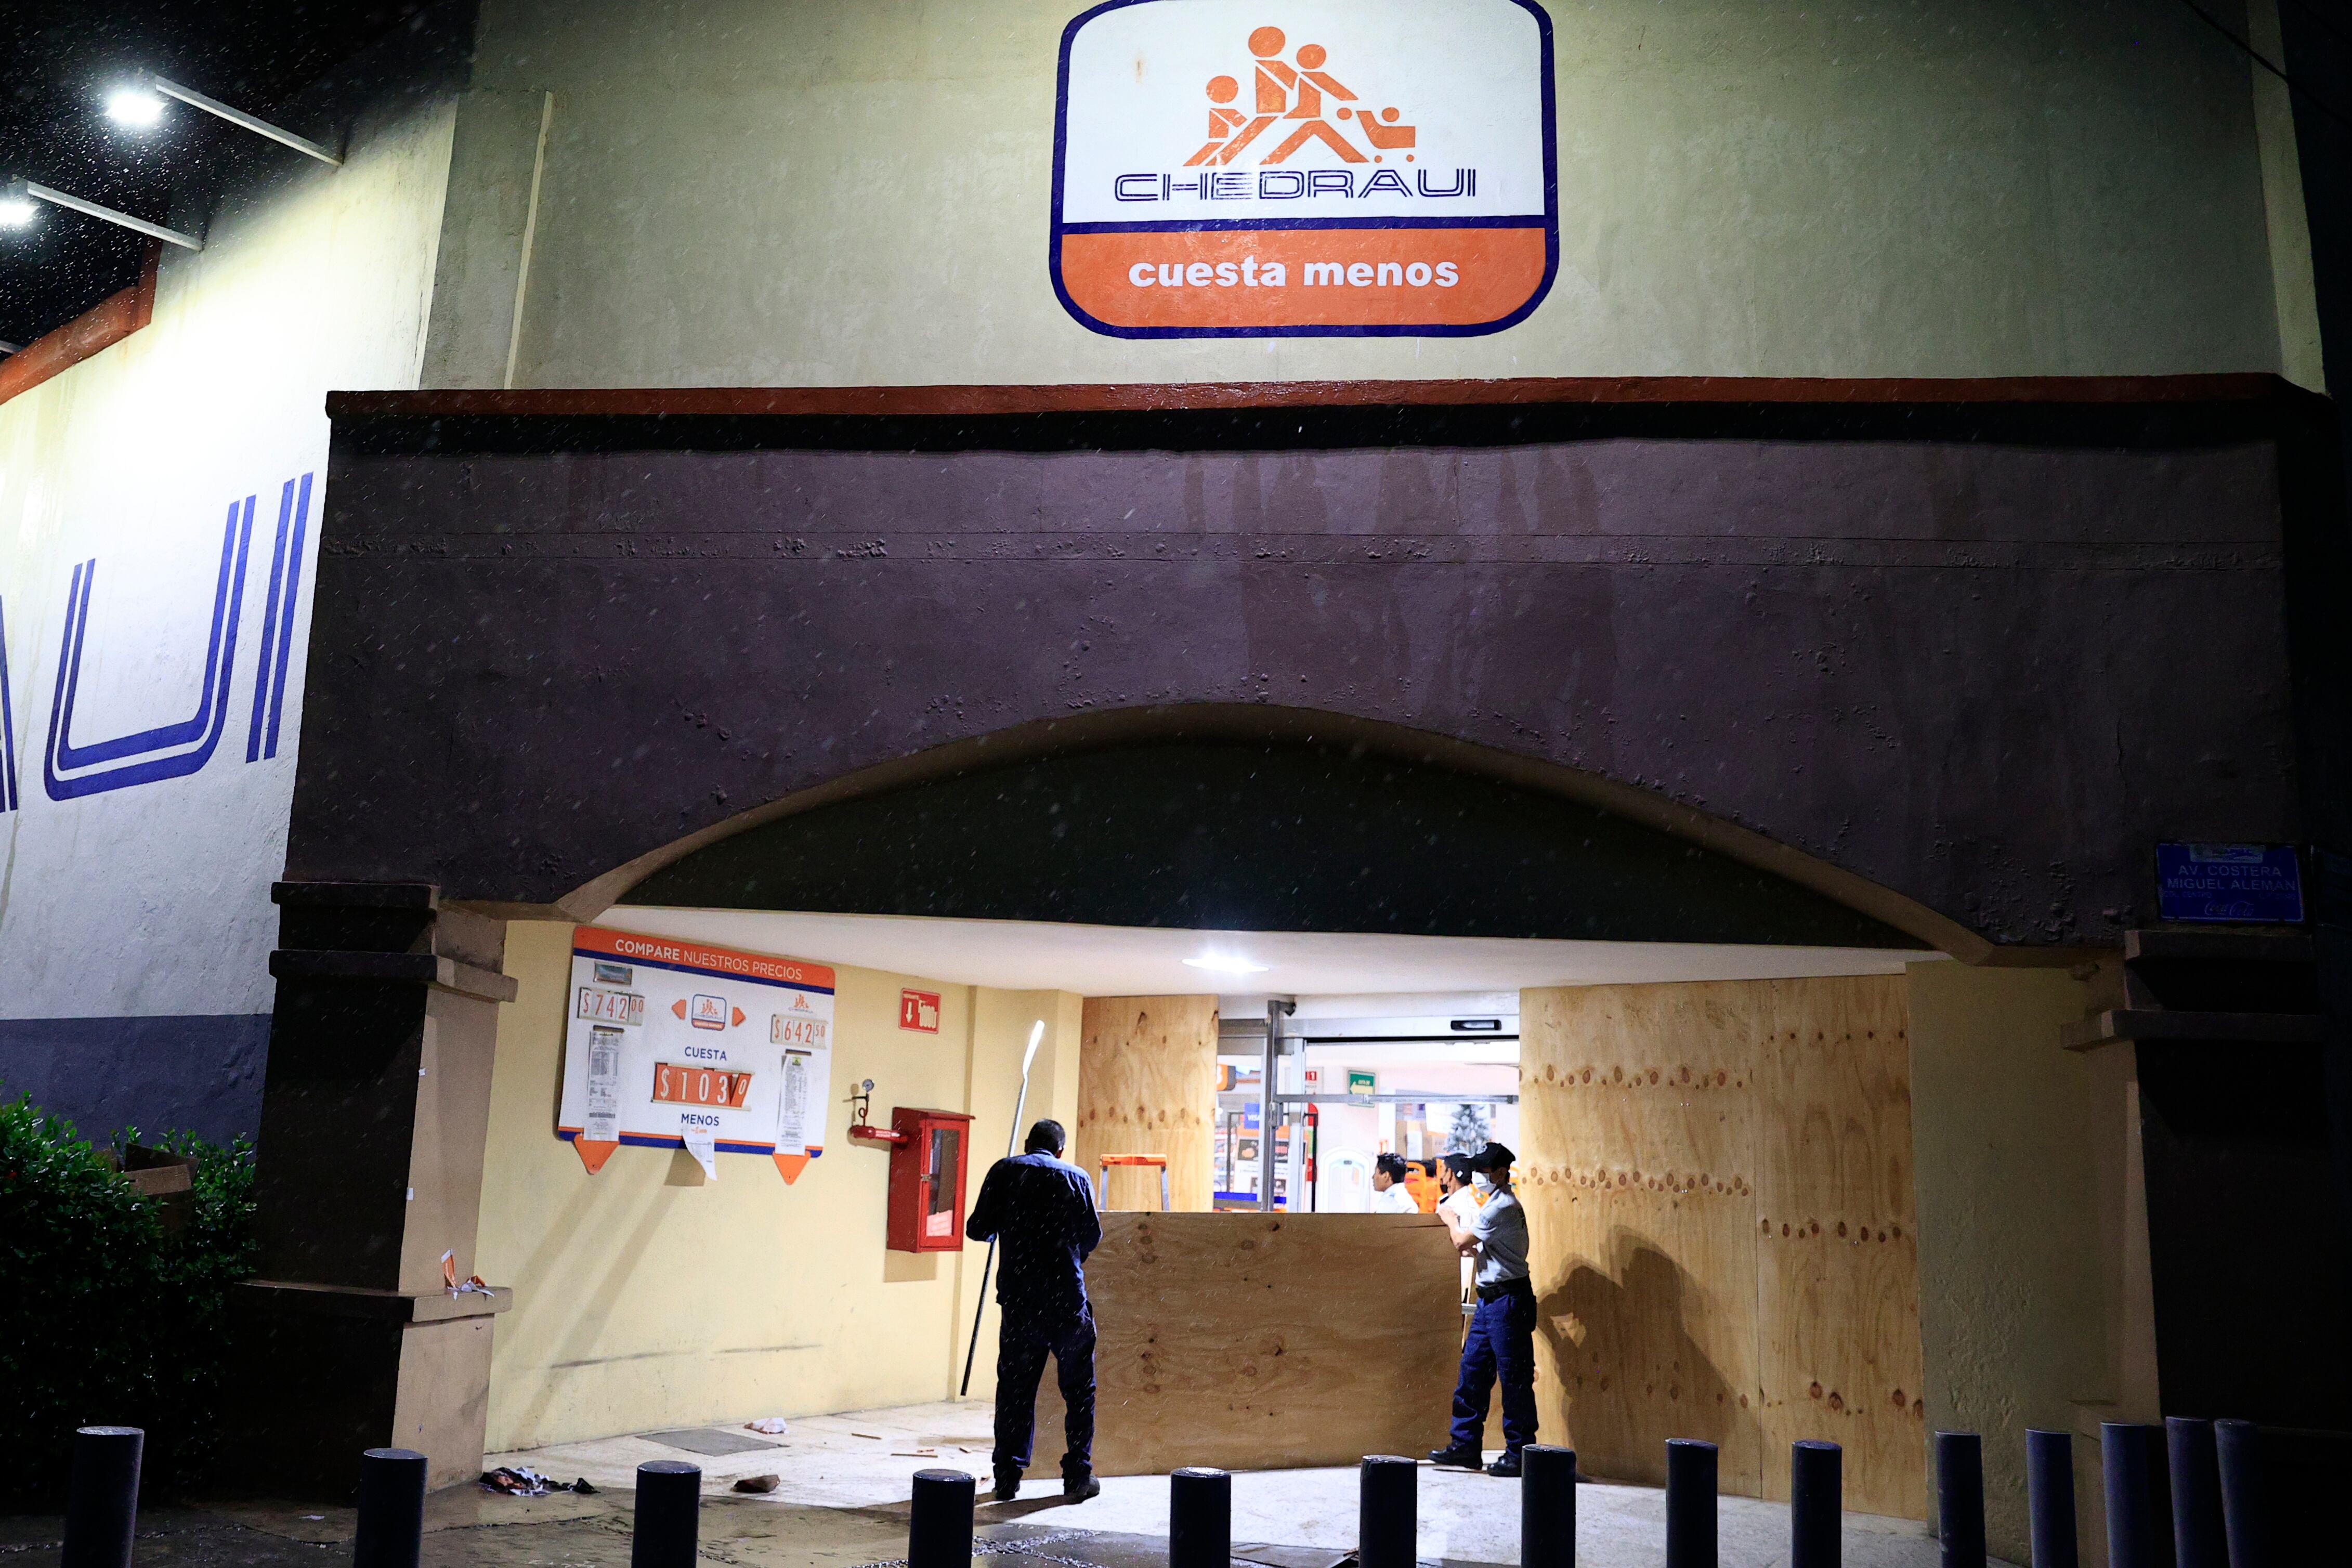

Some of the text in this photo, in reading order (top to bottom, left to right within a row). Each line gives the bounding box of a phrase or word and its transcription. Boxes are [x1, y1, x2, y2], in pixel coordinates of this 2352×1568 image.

[1114, 168, 1476, 202] CHEDRAUI
[1128, 256, 1460, 287] cuesta menos
[0, 472, 313, 813] UI
[2207, 865, 2282, 877] COSTERA
[2167, 878, 2226, 890] MIGUEL
[615, 938, 802, 981] COMPARE NUESTROS PRECIOS
[684, 1046, 727, 1061] CUESTA
[681, 1114, 720, 1127] MENOS
